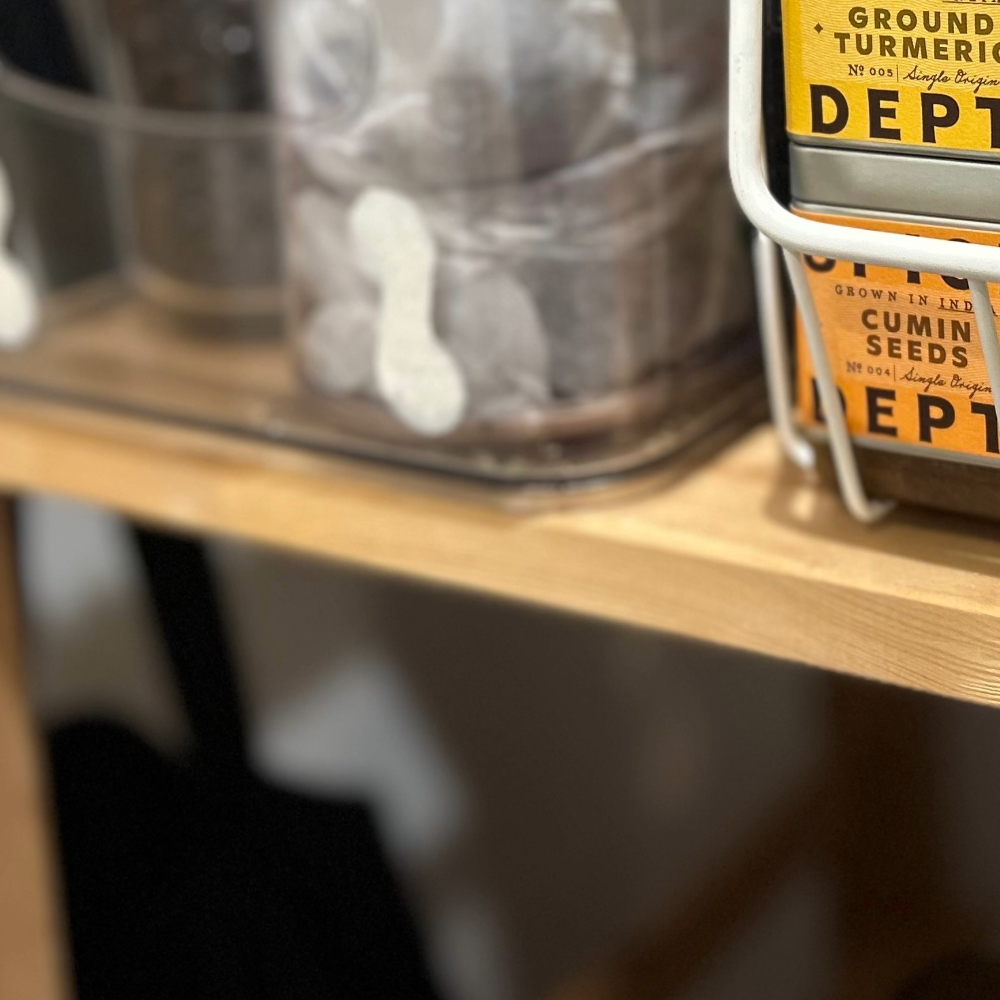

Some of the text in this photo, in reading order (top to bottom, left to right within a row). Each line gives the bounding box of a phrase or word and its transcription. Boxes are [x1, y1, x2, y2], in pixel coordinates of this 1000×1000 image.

[848, 6, 994, 36] GROUND
[869, 67, 893, 77] 005
[903, 65, 951, 91] Single
[954, 69, 1000, 93] Origin
[834, 283, 998, 317] GROWN IN IND
[861, 308, 972, 343] CUMIN
[866, 334, 968, 368] SEEDS
[867, 365, 891, 377] 004
[900, 366, 946, 392] Single
[950, 372, 992, 399] Origin
